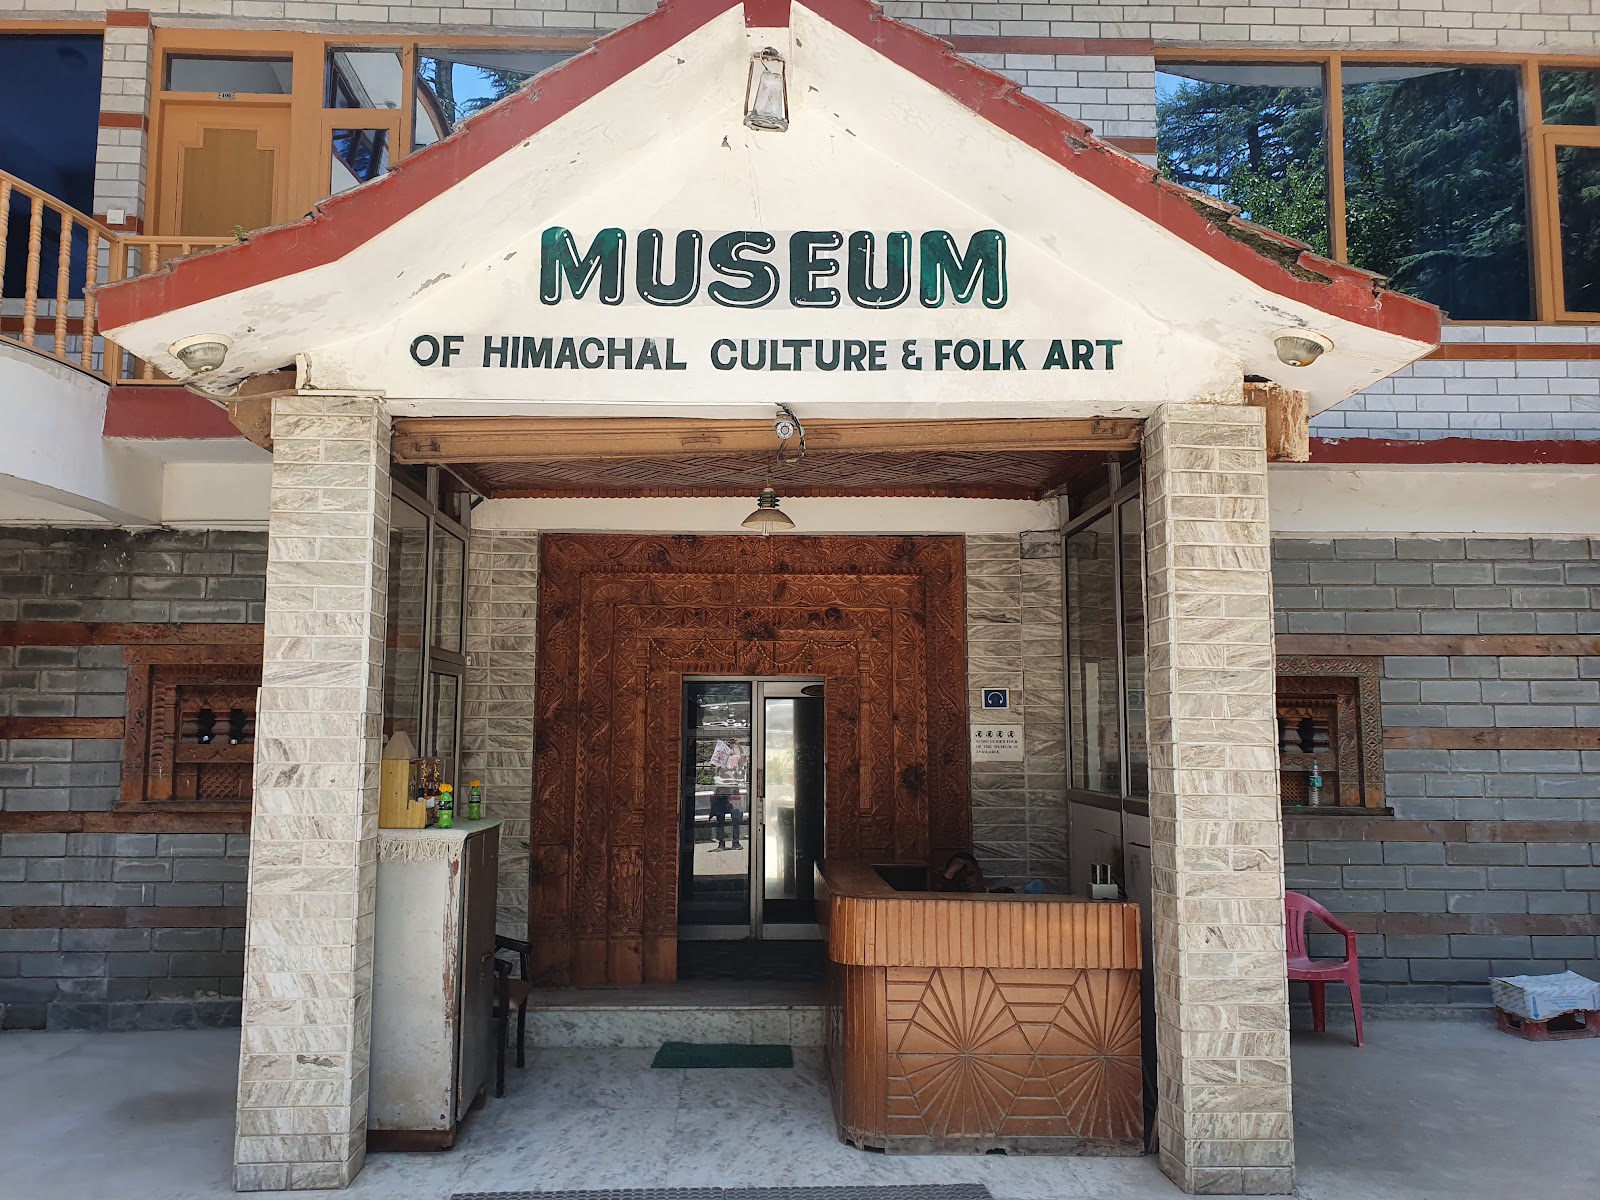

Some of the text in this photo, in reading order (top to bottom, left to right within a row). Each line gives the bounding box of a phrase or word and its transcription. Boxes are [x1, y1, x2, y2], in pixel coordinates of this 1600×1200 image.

[540, 226, 1007, 309] MUSEUM
[410, 335, 1123, 371] OF HIMACHAL CULTURE & FOLK ART
